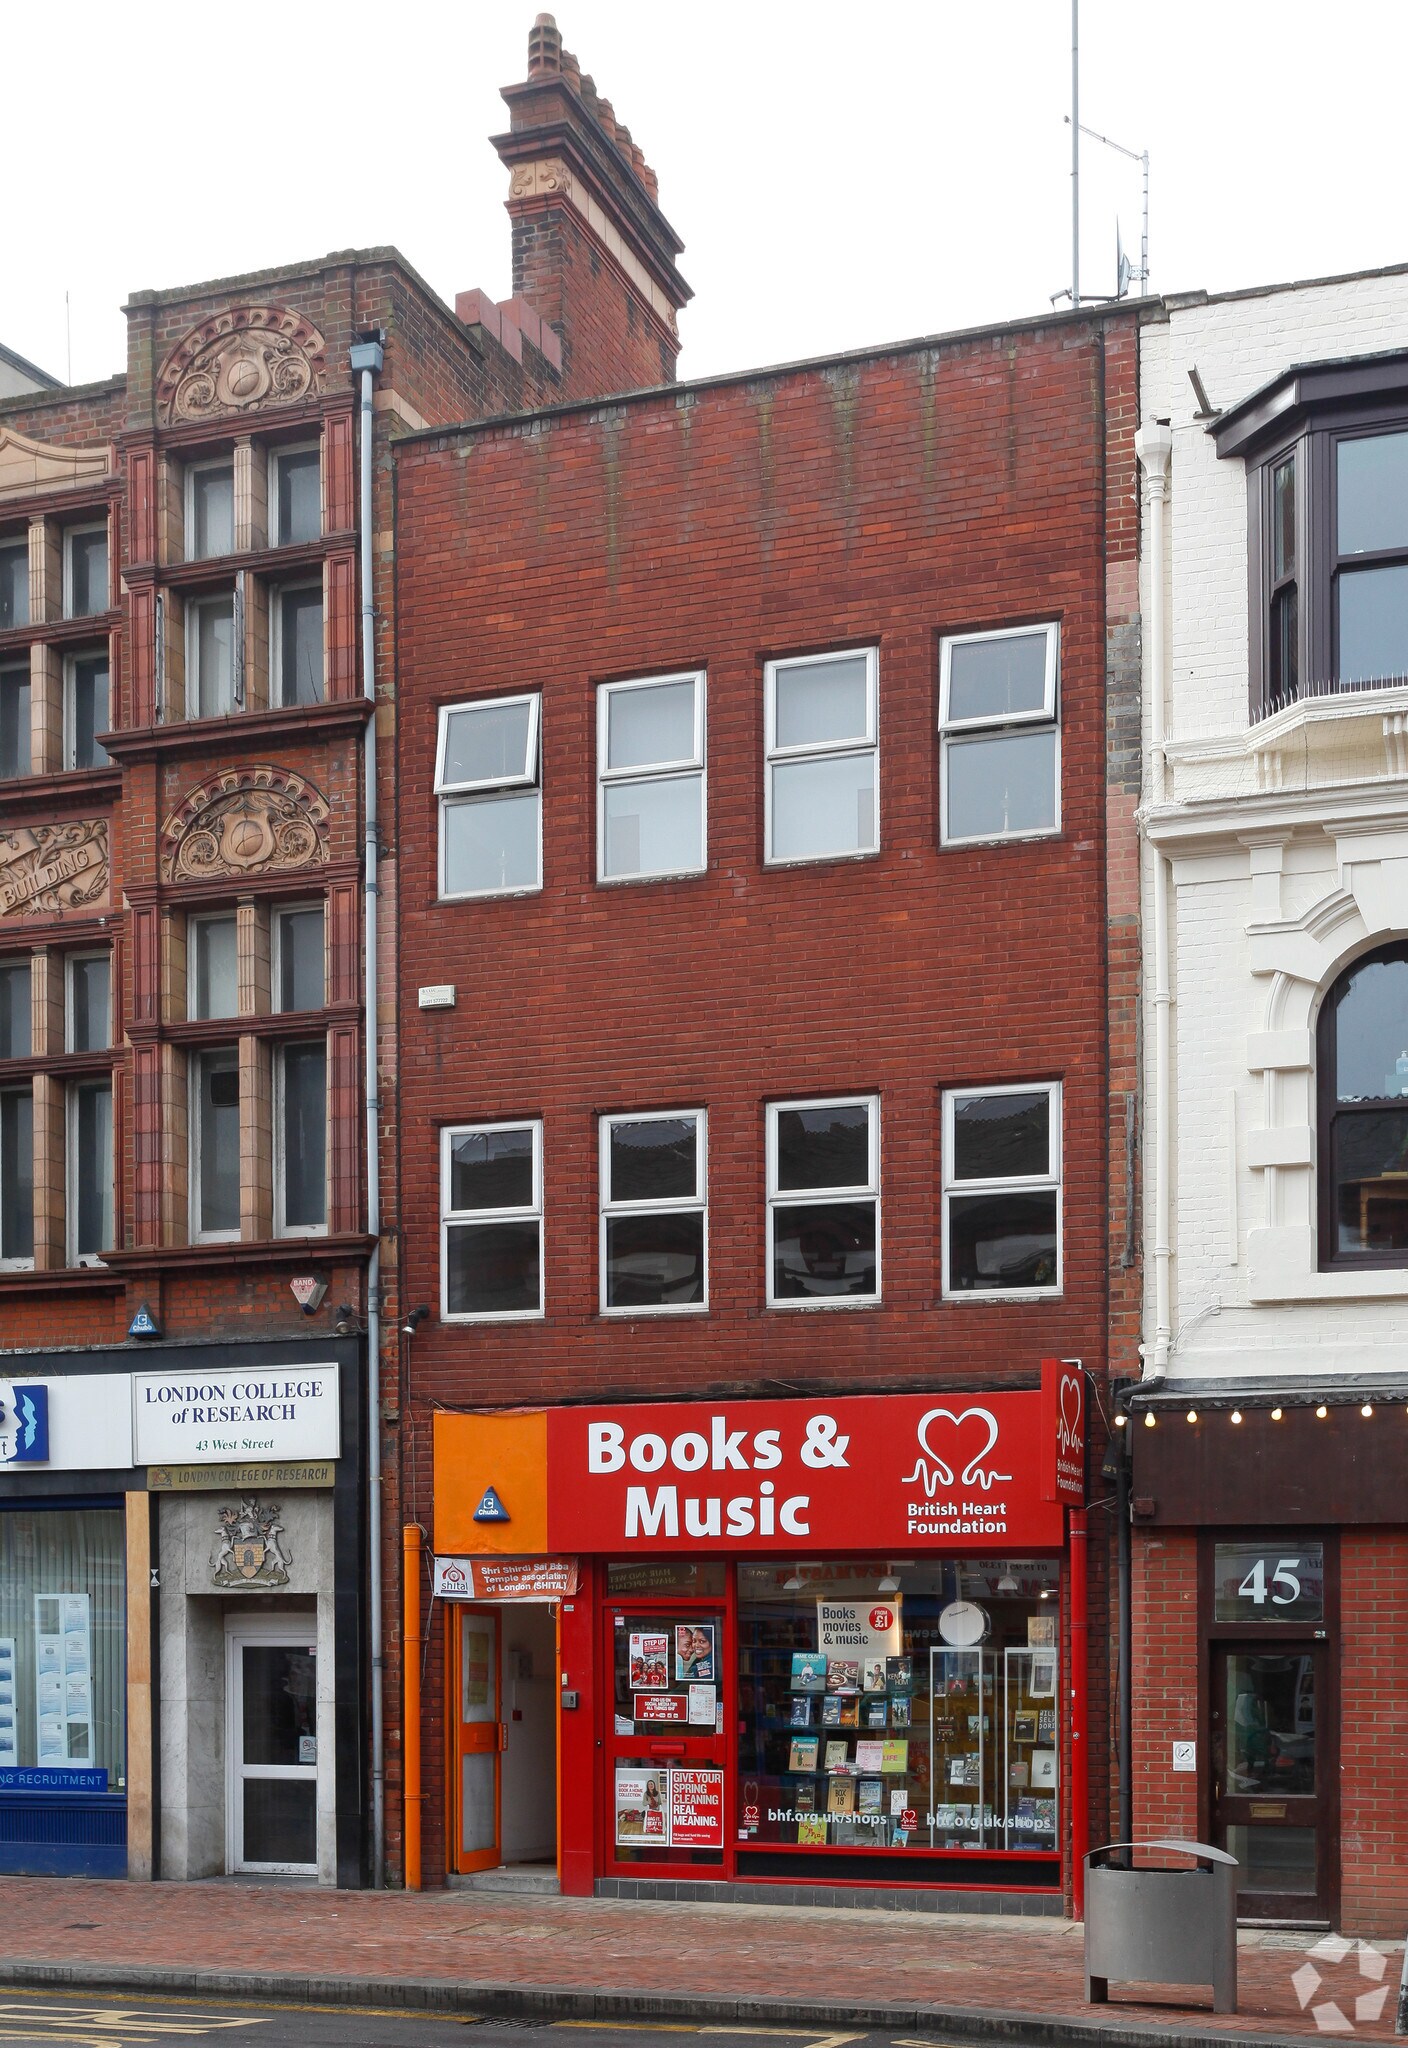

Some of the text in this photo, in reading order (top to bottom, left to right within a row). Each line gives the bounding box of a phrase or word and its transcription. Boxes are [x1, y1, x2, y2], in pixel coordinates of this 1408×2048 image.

[4, 849, 90, 908] BUILDING
[145, 1381, 323, 1403] LONDON COLLEGE
[172, 1404, 296, 1424] of RESEARCH
[195, 1438, 274, 1451] 43 West Street
[588, 1414, 850, 1474] Books &
[1056, 1459, 1083, 1477] British Heart
[178, 1468, 328, 1483] LONDON COLLEGE OF RESEARCH
[1056, 1475, 1083, 1493] Foundation
[624, 1481, 810, 1538] Music
[907, 1501, 1007, 1517] British Heart
[907, 1518, 1007, 1534] Foundation
[481, 1567, 500, 1575] Shri
[503, 1565, 531, 1574] Shirdi
[534, 1563, 547, 1571] Sai
[441, 1581, 468, 1591] shital
[484, 1575, 519, 1584] Temple
[1238, 1559, 1301, 1604] 45
[498, 1582, 531, 1592] London
[822, 1607, 856, 1619] Books
[823, 1620, 861, 1632] movies
[875, 1615, 888, 1628] £1
[823, 1632, 869, 1645] & music
[18, 1774, 102, 1786] RECRUITMENT
[673, 1772, 721, 1783] GIVE YOUR
[673, 1783, 707, 1794] SPRING
[835, 1789, 847, 1797] BOX
[673, 1794, 719, 1805] CLEANING
[837, 1797, 845, 1806] 18
[673, 1804, 697, 1815] REAL
[673, 1815, 719, 1827] MEANING.
[768, 1809, 887, 1828] bhf.org.uk/shops
[926, 1812, 1051, 1832] bhf.org.uk/shops
